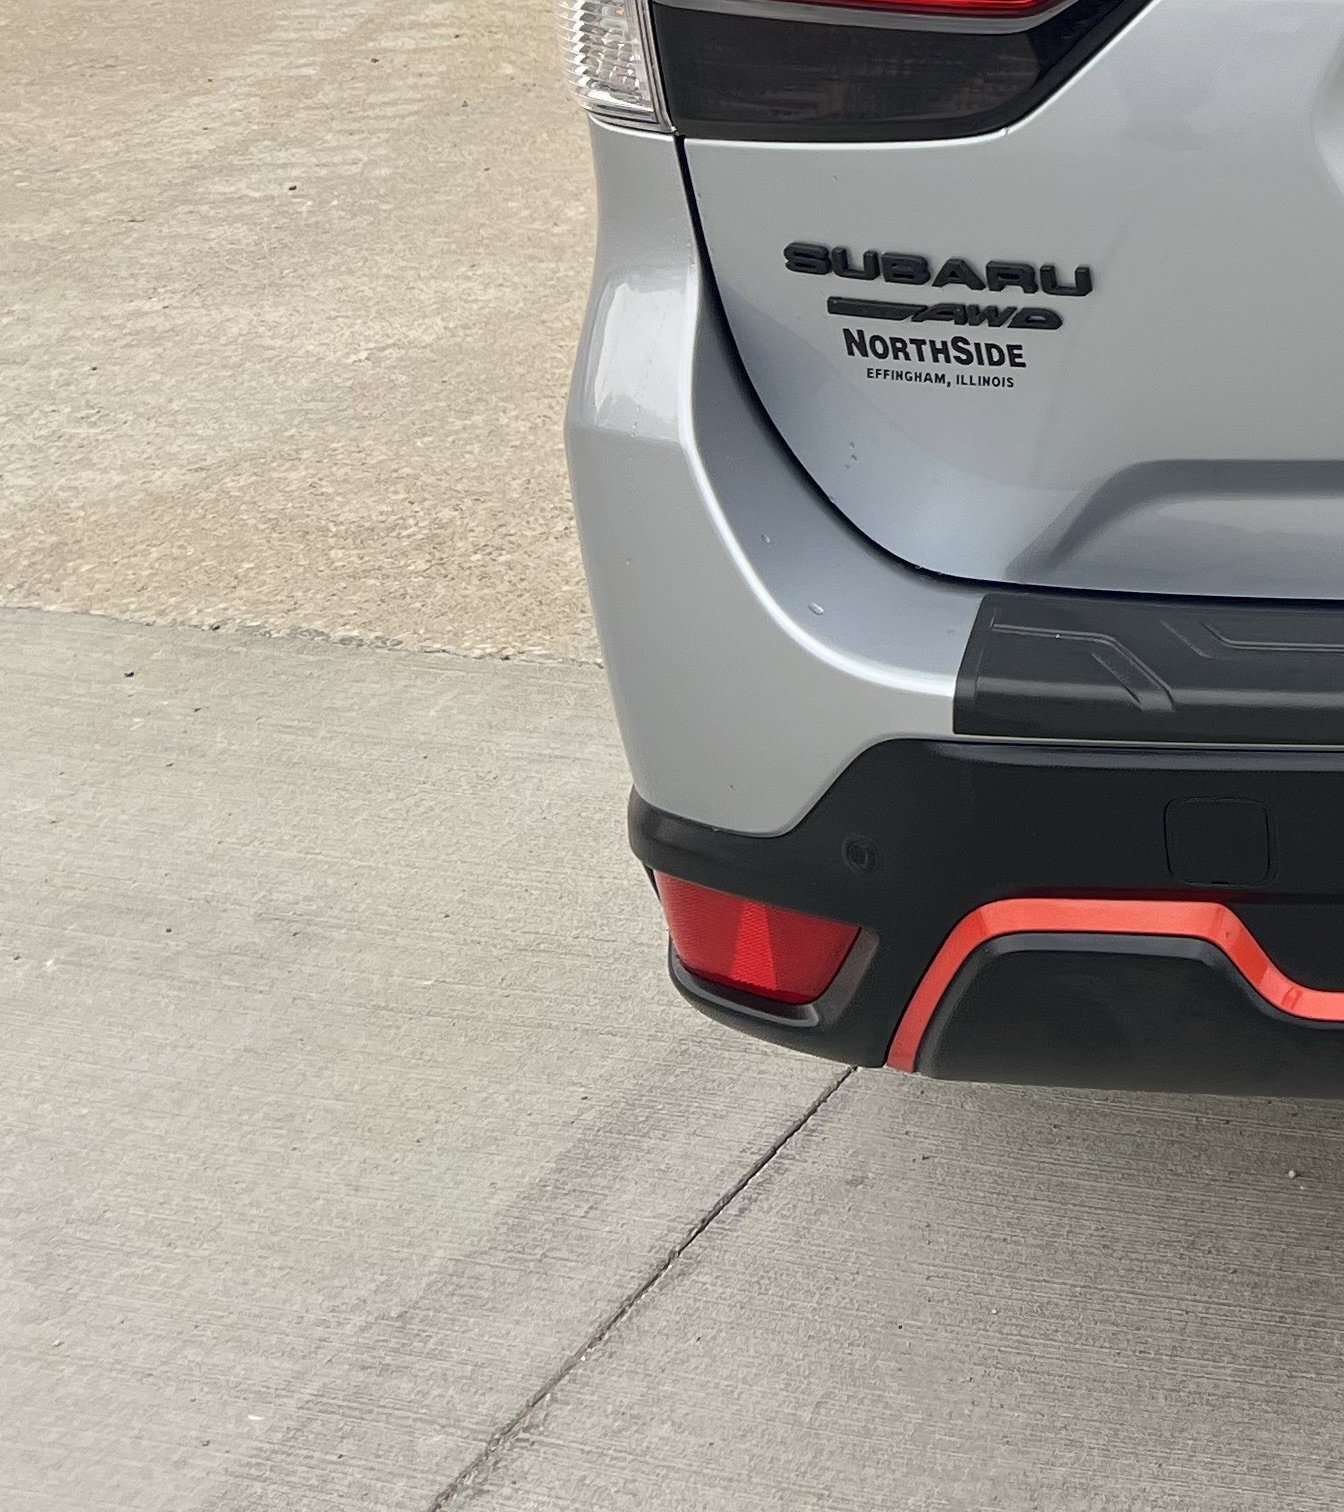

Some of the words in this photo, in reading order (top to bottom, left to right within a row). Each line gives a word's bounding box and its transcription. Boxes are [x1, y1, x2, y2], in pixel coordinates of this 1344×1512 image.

[783, 242, 1094, 297] SUBARU
[910, 302, 1064, 330] AWD
[866, 367, 952, 388] EFFINGHAM,
[956, 375, 1015, 389] ILLINOIS
